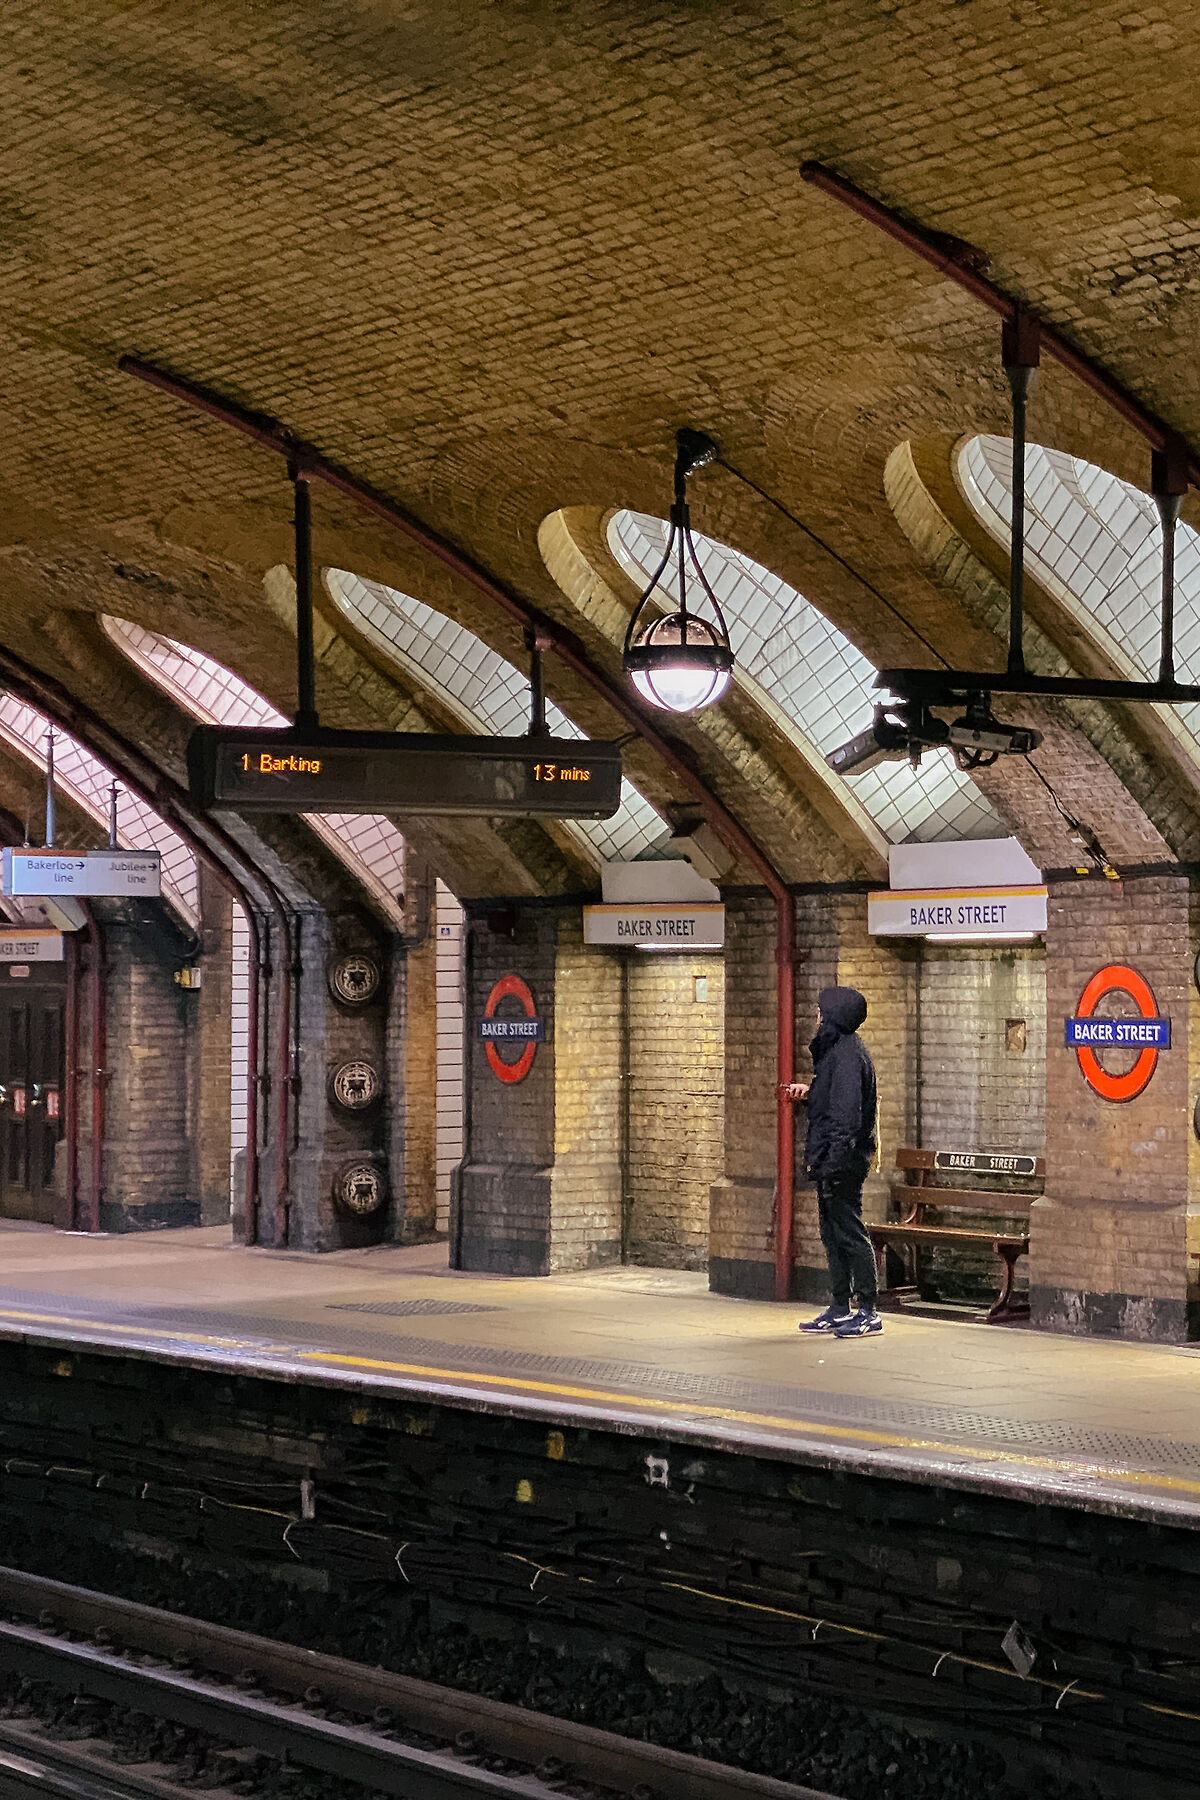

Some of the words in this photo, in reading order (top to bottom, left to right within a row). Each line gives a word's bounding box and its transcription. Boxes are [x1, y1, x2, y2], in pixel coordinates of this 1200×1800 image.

[241, 753, 248, 771] 1
[260, 753, 320, 773] Barking
[533, 764, 556, 781] 13
[560, 766, 590, 781] mins
[27, 860, 74, 871] Bakerloo
[110, 861, 146, 872] Jubilee
[54, 873, 74, 883] line
[127, 874, 146, 884] line
[910, 907, 953, 925] BAKER
[958, 905, 1007, 924] STREET
[617, 920, 652, 936] BAKER
[656, 920, 695, 936] STREET
[481, 1023, 508, 1036] BAKER
[509, 1022, 538, 1036] STREET
[1074, 1023, 1113, 1041] BAKER
[1116, 1024, 1160, 1042] STREET
[949, 1155, 975, 1168] BAKER
[990, 1157, 1018, 1170] STREET
